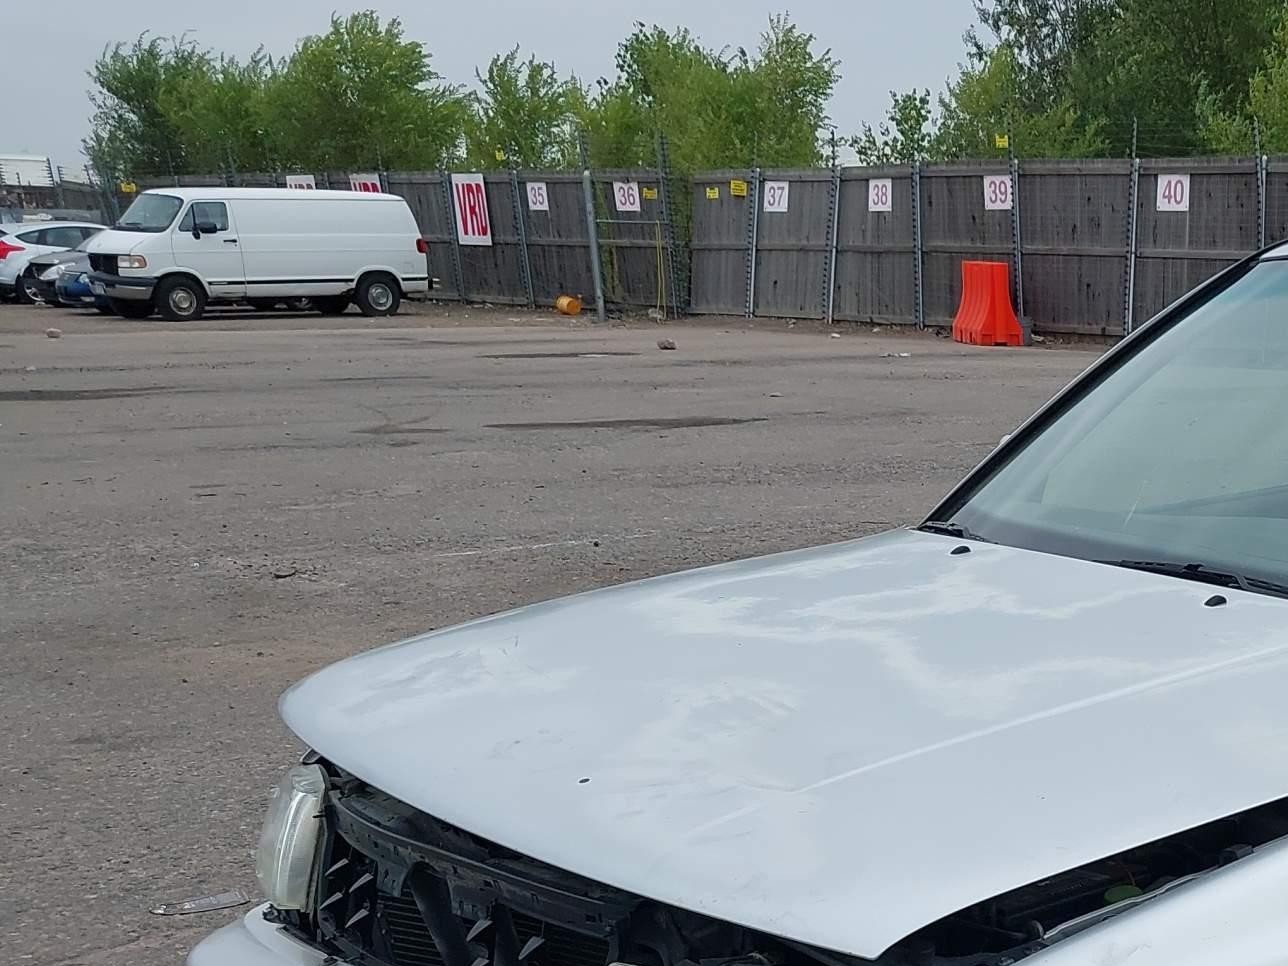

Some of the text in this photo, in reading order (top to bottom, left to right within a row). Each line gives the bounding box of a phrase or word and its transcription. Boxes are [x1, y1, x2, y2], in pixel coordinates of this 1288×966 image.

[530, 186, 545, 206] 35
[618, 186, 636, 206] 36
[767, 186, 785, 207] 37
[872, 184, 888, 206] 38
[988, 180, 1008, 204] 39
[1162, 179, 1185, 205] 40
[455, 183, 489, 237] VRD
